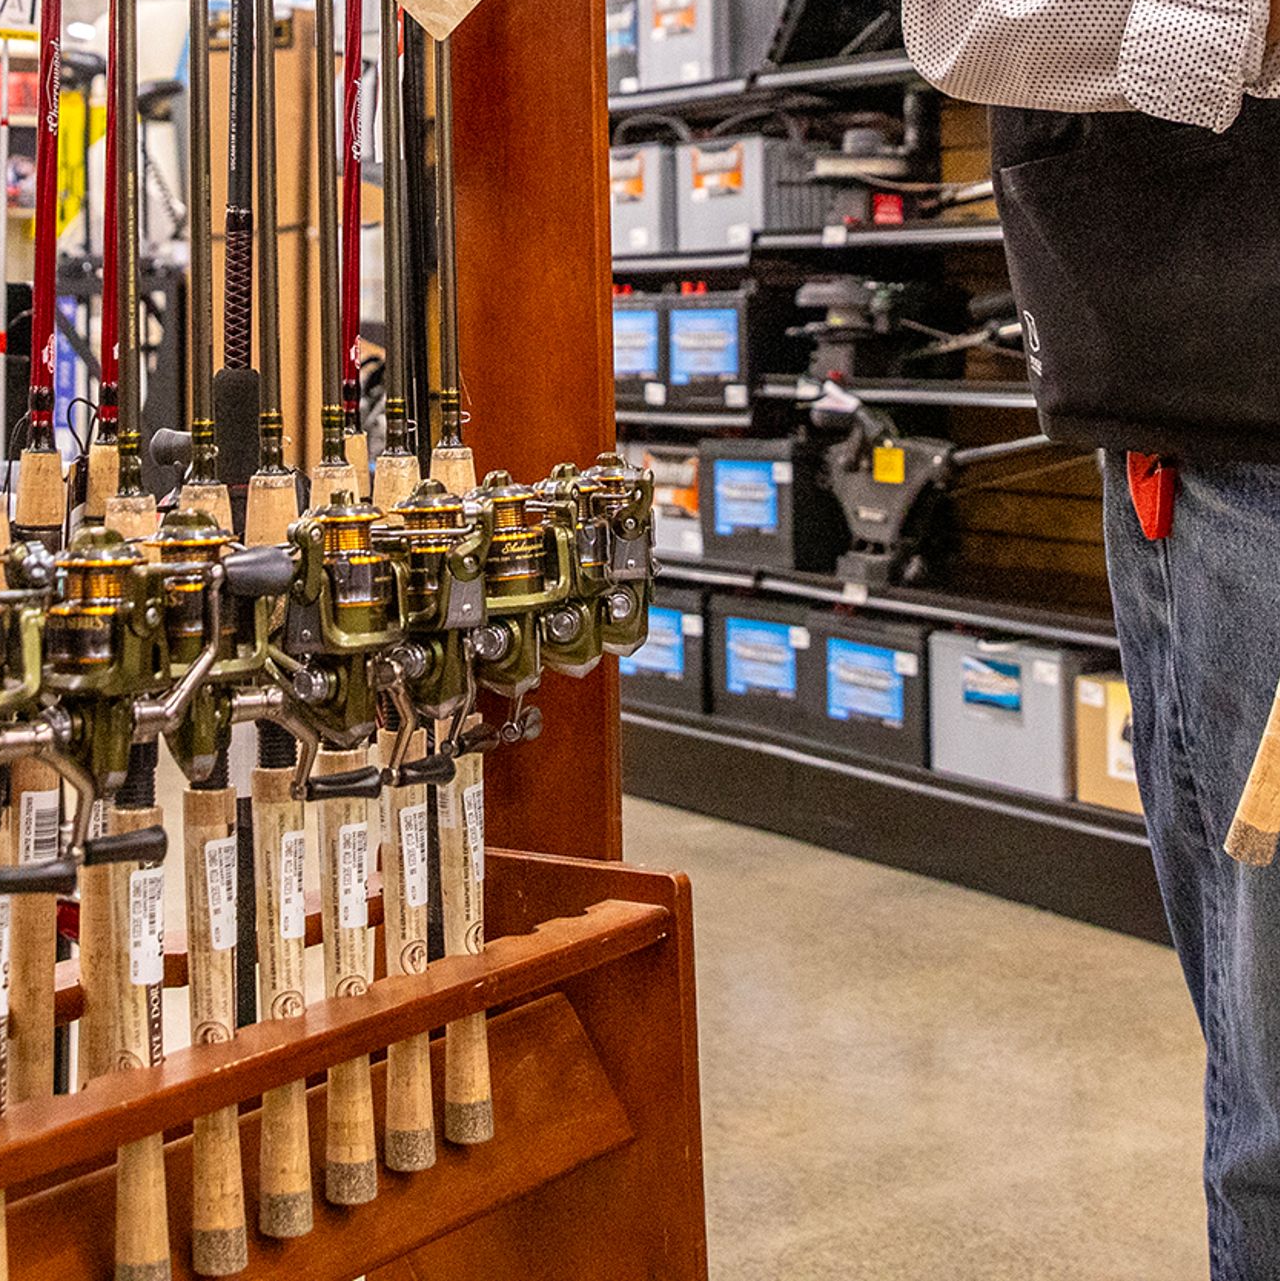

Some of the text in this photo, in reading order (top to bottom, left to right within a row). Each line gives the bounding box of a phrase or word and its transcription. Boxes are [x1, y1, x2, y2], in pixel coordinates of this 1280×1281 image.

[44, 37, 62, 136] Cherrywood
[149, 985, 162, 1067] LEYE DOR
